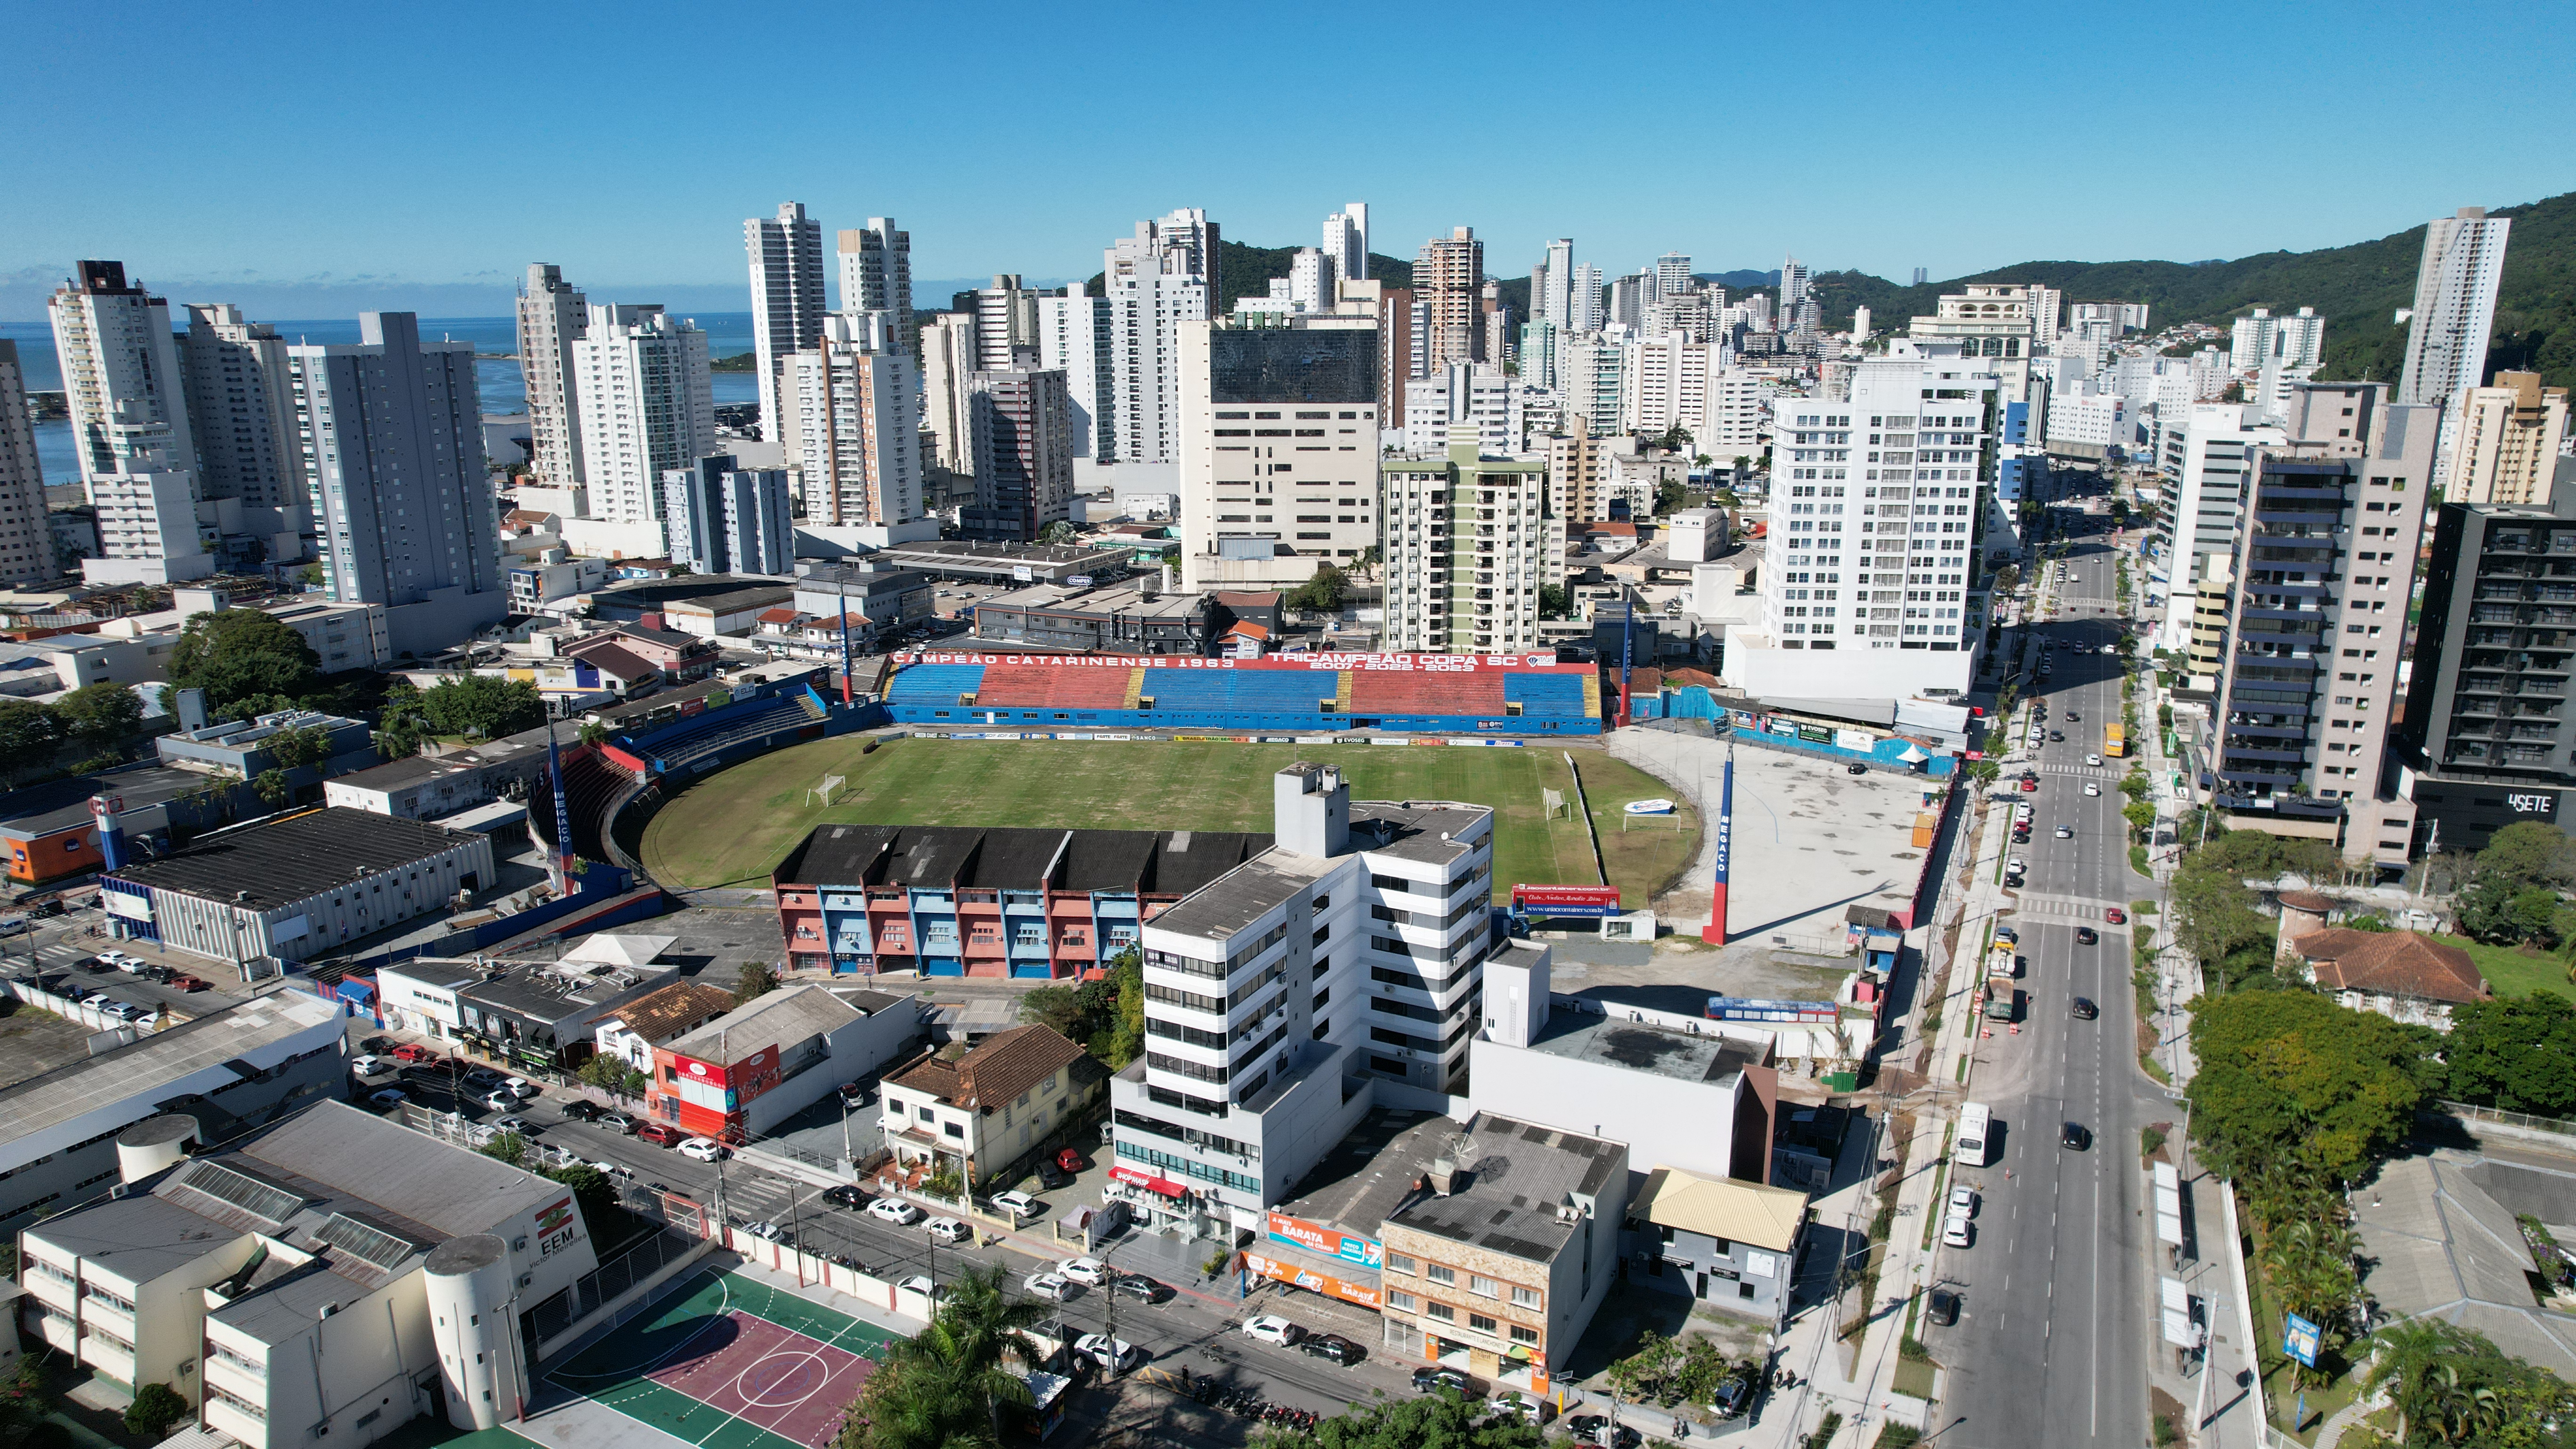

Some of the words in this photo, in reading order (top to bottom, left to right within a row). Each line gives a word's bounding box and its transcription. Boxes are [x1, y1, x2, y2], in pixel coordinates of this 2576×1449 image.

[1088, 555, 1106, 565] CASAS
[893, 652, 997, 665] CAMPEÃO
[1006, 655, 1167, 668] CATARINENSE
[1178, 658, 1235, 668] 1963
[1268, 652, 1411, 664] TRICAMPEÃO
[1419, 655, 1479, 666] COPA
[1487, 656, 1518, 666] SC
[1807, 725, 1828, 733] EVOSEG
[1842, 739, 1868, 749] Curumim
[2508, 793, 2552, 813] 4SETE
[556, 791, 569, 843] MEGAÇO
[1717, 815, 1729, 871] MEGAÇO
[1116, 1172, 1149, 1187] SHOPMASP
[1278, 1219, 1292, 1227] MAIS
[541, 1226, 574, 1256] EEM
[1282, 1225, 1323, 1244] BARATA
[553, 1232, 588, 1256] Meirelles
[1314, 1242, 1335, 1253] CIDADE
[1342, 1246, 1362, 1256] MÁXIMO
[1344, 1241, 1360, 1250] PREÇO
[1341, 1286, 1375, 1303] BARATA
[1449, 1329, 1476, 1341] RESTAURANTE
[1480, 1338, 1506, 1350] LANCHONETE
